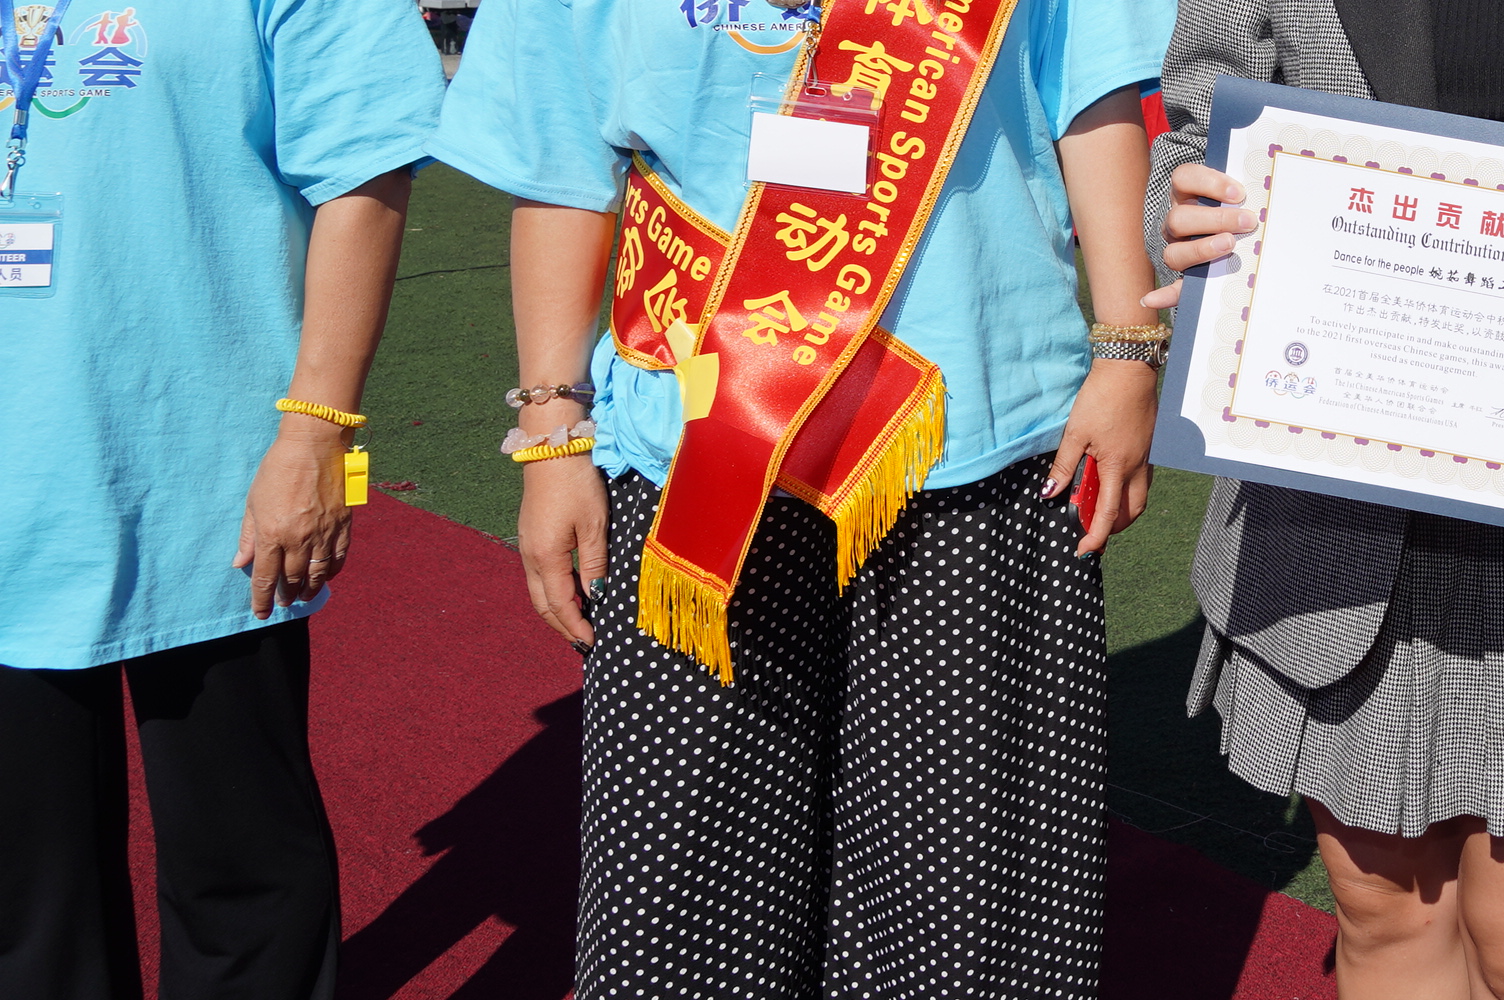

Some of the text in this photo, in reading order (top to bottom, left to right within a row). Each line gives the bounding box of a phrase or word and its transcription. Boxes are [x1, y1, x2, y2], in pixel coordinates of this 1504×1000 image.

[713, 22, 766, 32] CHINESE
[41, 89, 75, 97] SPORTS
[79, 89, 111, 97] GAME
[852, 131, 926, 256] Sports
[626, 177, 712, 281] rts Game
[1331, 215, 1416, 249] Outstanding
[0, 253, 26, 262] TEER
[1333, 250, 1362, 265] Dance
[1364, 255, 1376, 267] for
[1377, 258, 1391, 270] the
[1393, 261, 1425, 276] people
[791, 264, 872, 366] Game
[1297, 326, 1305, 334] to
[1307, 328, 1320, 337] the
[1322, 330, 1343, 341] 2021
[1345, 333, 1362, 345] first
[1364, 339, 1401, 351] overseas
[1403, 345, 1438, 359] Chinese
[1439, 353, 1469, 365] games,
[1471, 357, 1488, 368] this
[1310, 316, 1321, 325] To
[1322, 318, 1356, 333] actively
[1358, 325, 1404, 340] participate
[1406, 332, 1415, 341] in
[1416, 333, 1432, 345] and
[1434, 340, 1457, 350] make
[1370, 351, 1397, 363] issued
[1398, 357, 1408, 365] as
[1265, 377, 1316, 395] 侨运会
[1335, 378, 1444, 405] The 1st Chinese American Sports Games
[1319, 396, 1458, 429] Federation of Chinese American Associations USA
